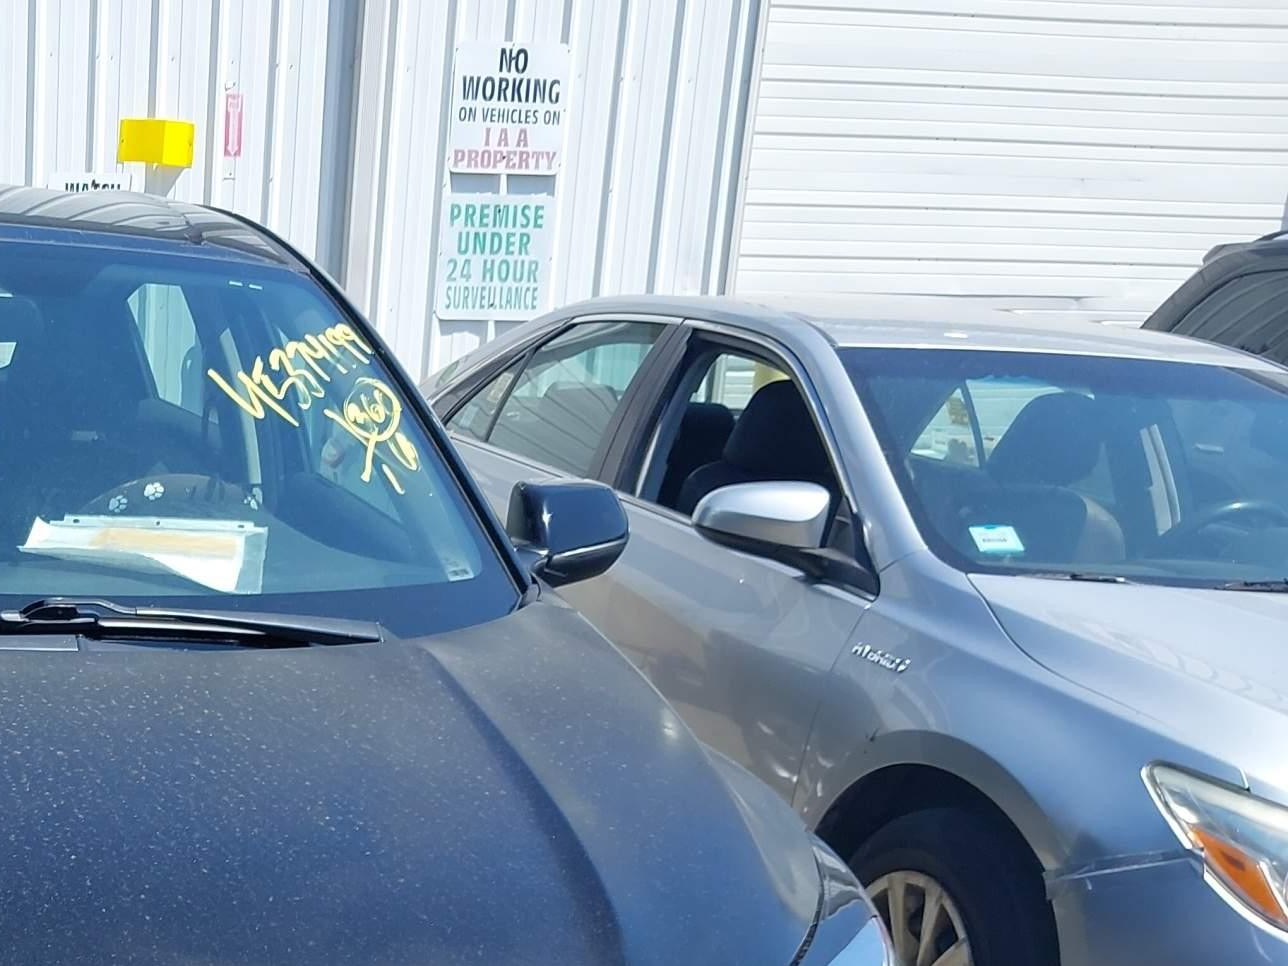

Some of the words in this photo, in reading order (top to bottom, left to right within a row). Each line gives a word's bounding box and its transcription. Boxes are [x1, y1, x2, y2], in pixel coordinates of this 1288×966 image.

[499, 48, 529, 73] NO
[462, 75, 561, 104] WORKING
[458, 106, 477, 122] ON
[482, 107, 539, 125] VEHICLES
[543, 109, 561, 125] ON
[453, 149, 557, 170] PROPERTY
[450, 203, 545, 229] PREMISE
[457, 231, 531, 256] UNDER
[447, 258, 472, 282] 24
[482, 258, 539, 283] HOUR
[445, 285, 538, 310] SURVEILLANCE
